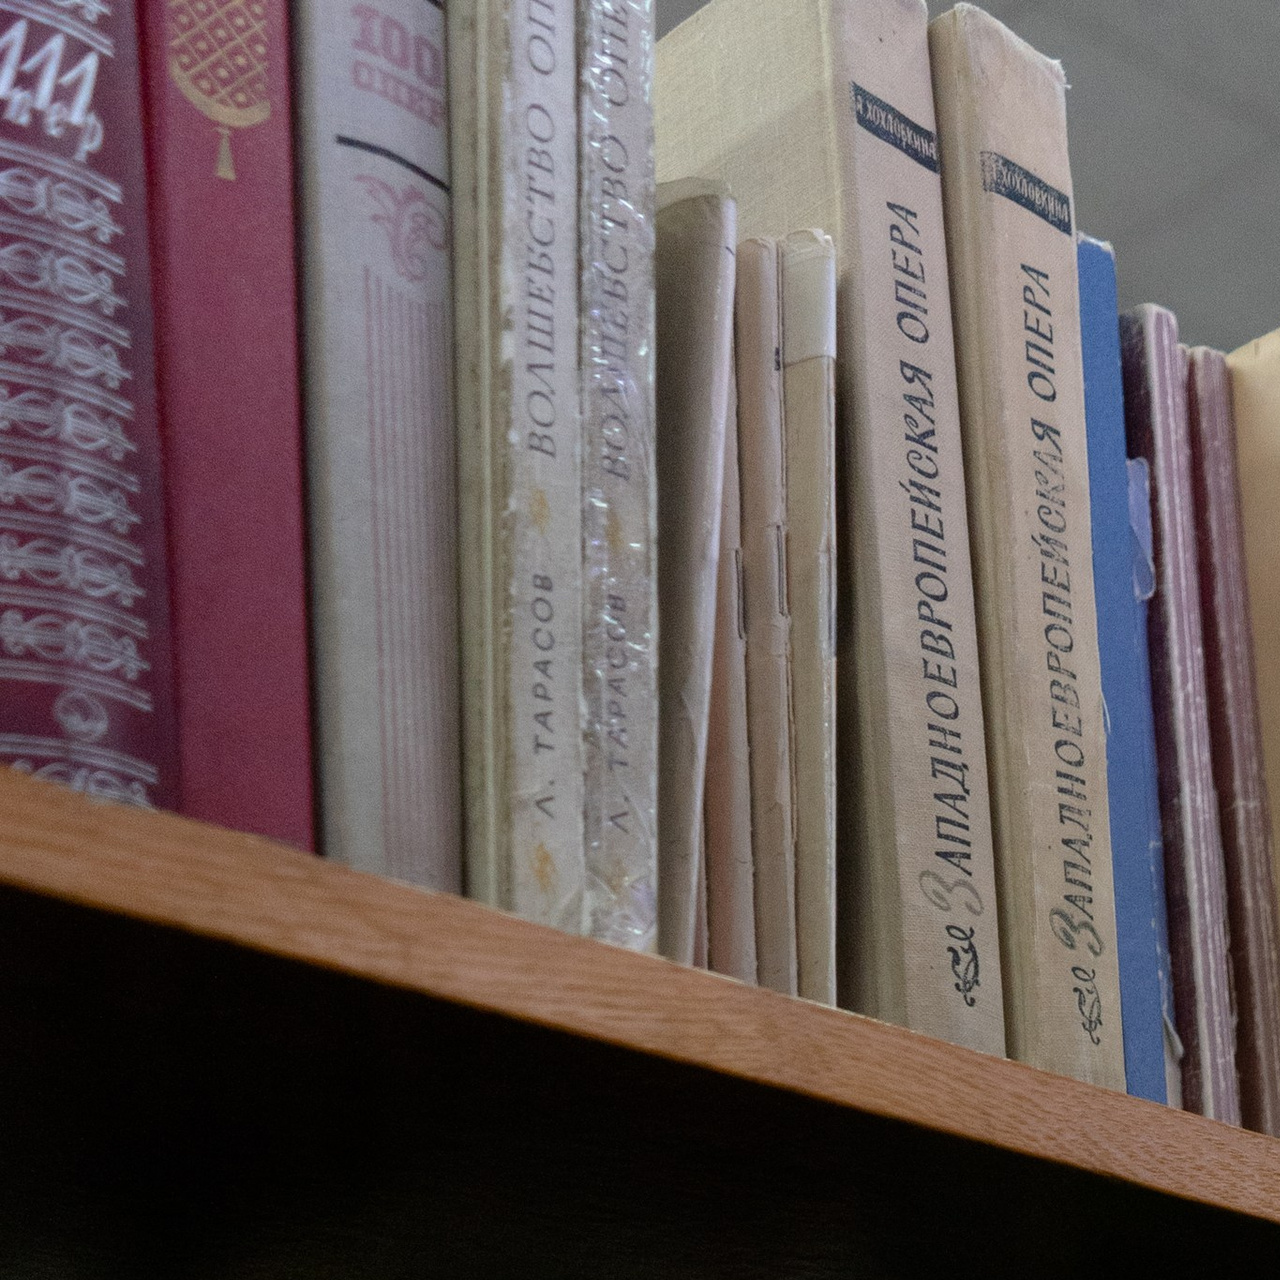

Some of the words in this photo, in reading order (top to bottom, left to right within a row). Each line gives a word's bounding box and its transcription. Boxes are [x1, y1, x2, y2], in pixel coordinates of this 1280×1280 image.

[350, 4, 443, 88] 100
[525, 103, 557, 460] ВОЛШЕБСТВО
[885, 201, 930, 346] ОПЕРА
[1019, 263, 1057, 404] ОПЕРА
[531, 572, 556, 756] ТАРАСОВ
[606, 592, 630, 772] ТАРАСОВ
[894, 360, 982, 915] ЗАПАДНОЕВРОПЕЙСКАЯ
[1031, 418, 1104, 955] ЗАПАДНОЕВРОПЕЙСКАЯ
